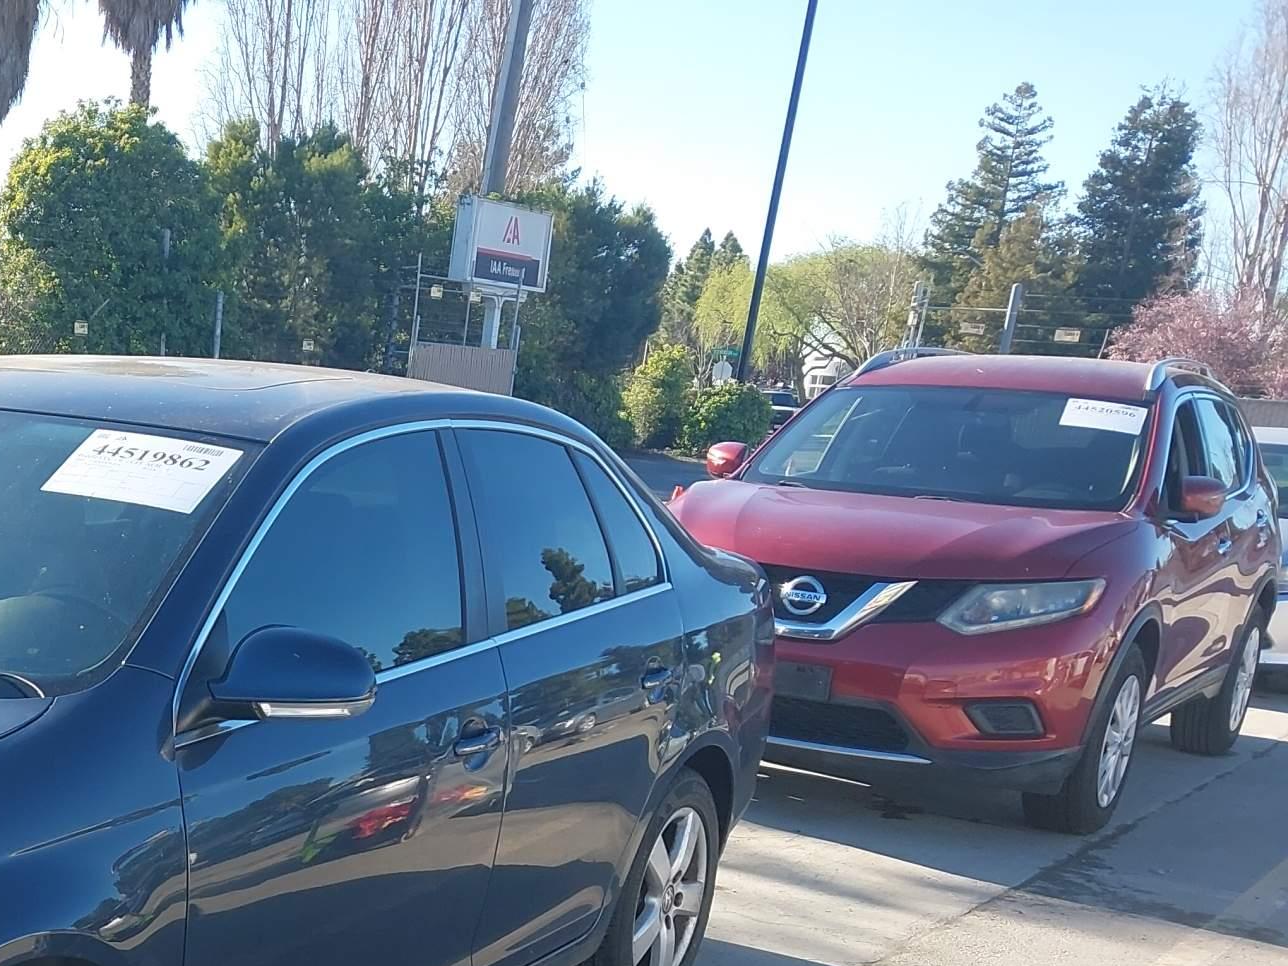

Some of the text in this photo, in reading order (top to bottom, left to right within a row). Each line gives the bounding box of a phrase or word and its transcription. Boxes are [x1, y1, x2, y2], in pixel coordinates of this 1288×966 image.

[490, 259, 502, 275] IAA
[1074, 404, 1136, 418] 44520596
[92, 443, 211, 472] 44519862
[784, 591, 821, 601] NISSAN
